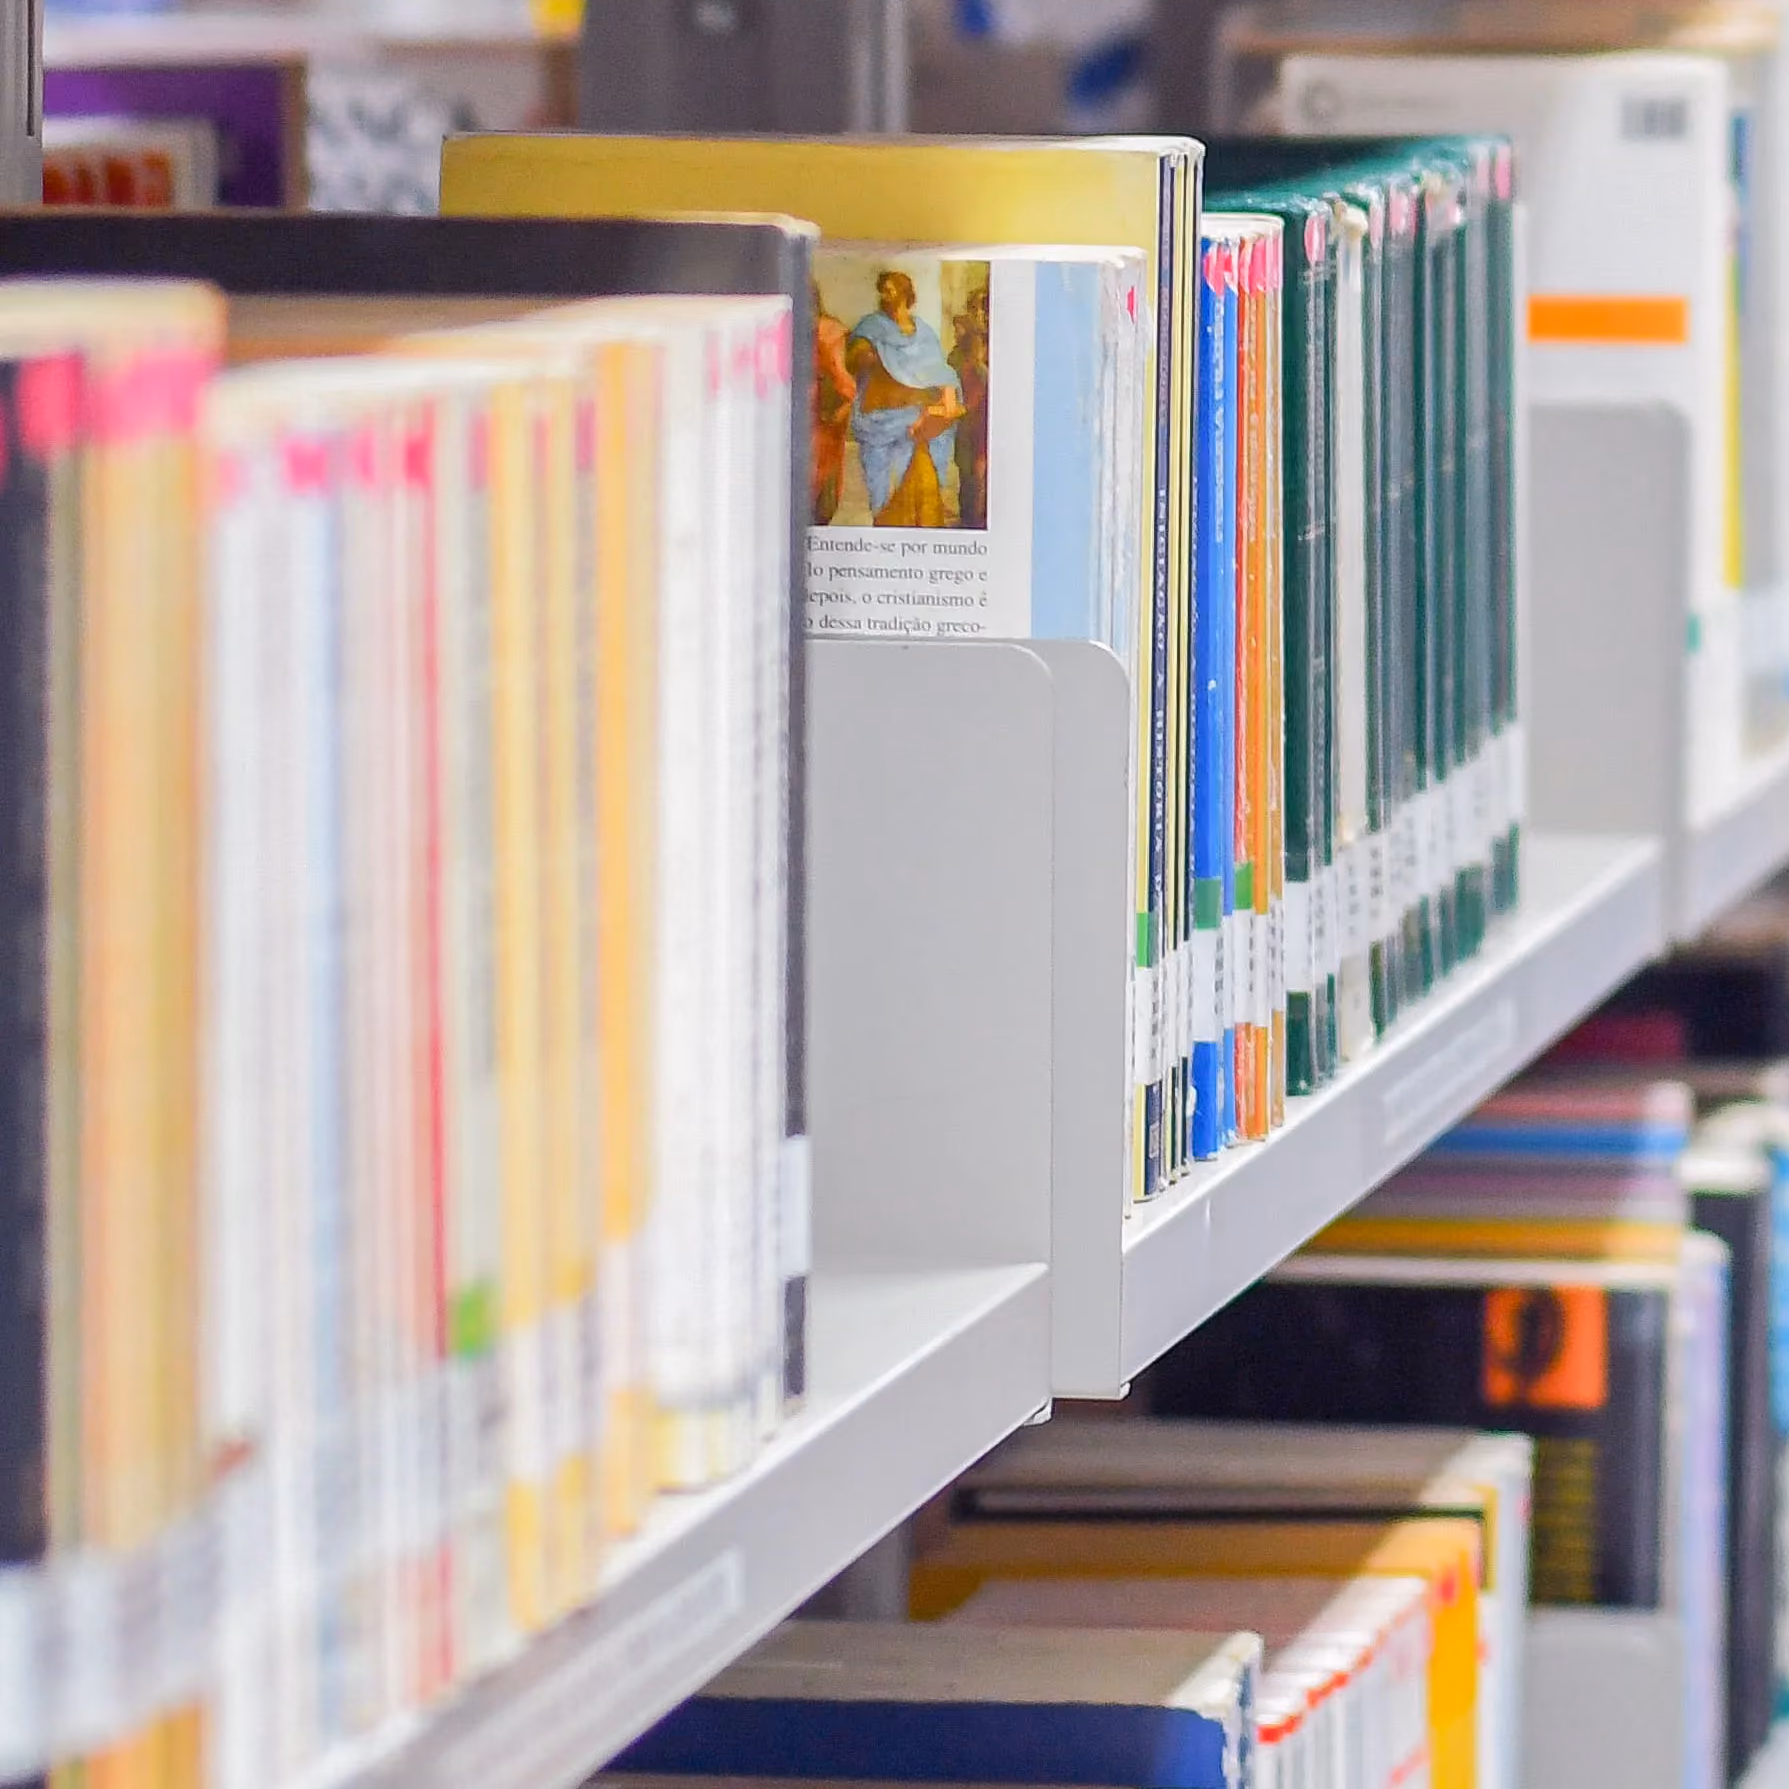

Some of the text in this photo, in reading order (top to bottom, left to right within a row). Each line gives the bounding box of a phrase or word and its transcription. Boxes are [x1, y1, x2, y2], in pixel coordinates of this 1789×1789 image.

[901, 542, 929, 558] por
[932, 540, 988, 557] mundo
[829, 565, 924, 582] pensamento
[929, 569, 974, 585] grego
[978, 571, 988, 582] e
[807, 588, 857, 607] epois,
[861, 593, 873, 605] o
[877, 589, 974, 607] cristianismo
[818, 614, 862, 630] dessa
[867, 615, 932, 634] tradição
